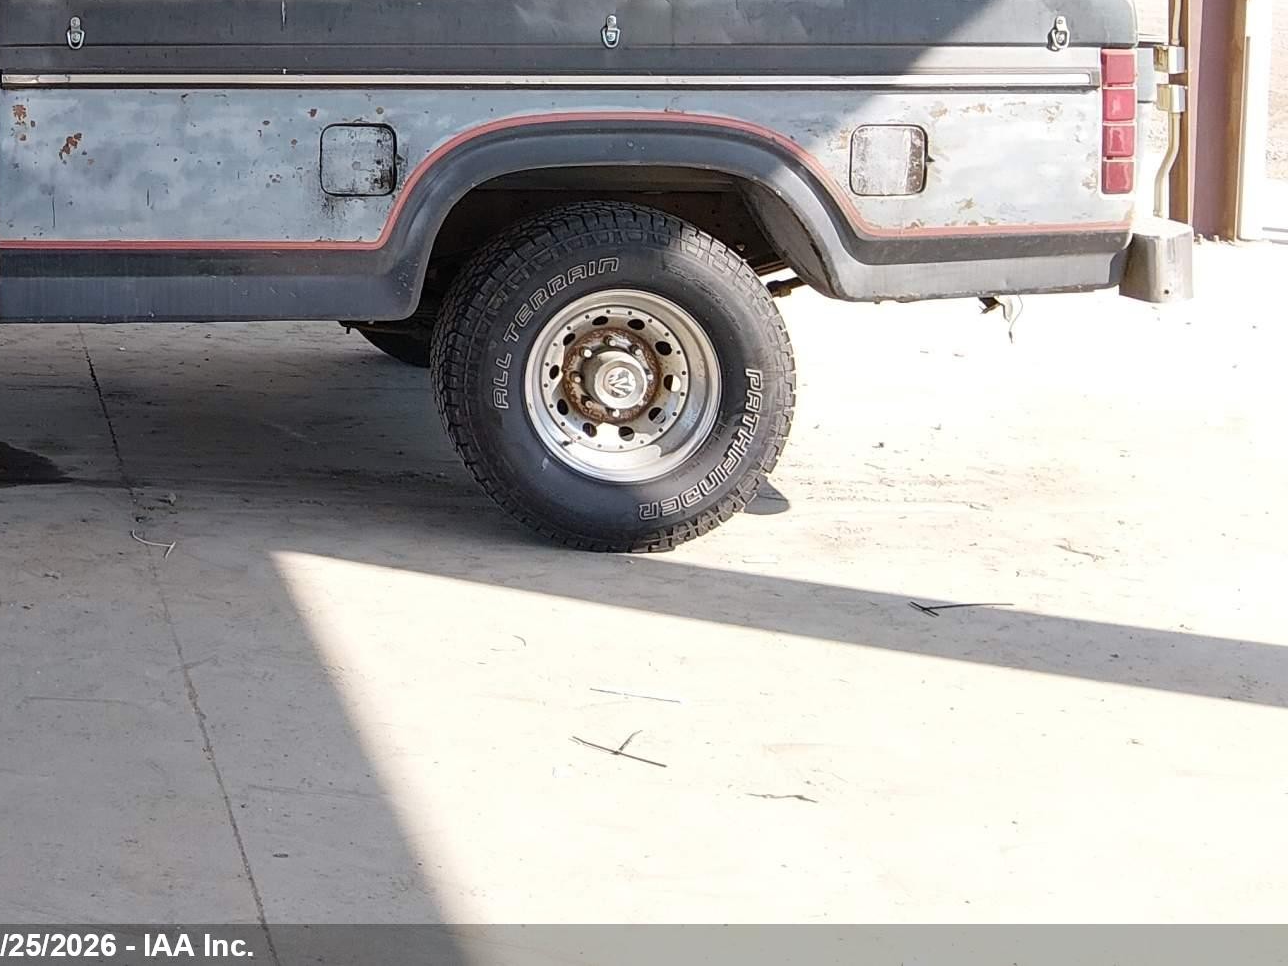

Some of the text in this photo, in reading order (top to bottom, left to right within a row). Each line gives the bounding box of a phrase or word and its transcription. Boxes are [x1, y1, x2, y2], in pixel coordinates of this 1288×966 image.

[492, 256, 620, 410] ALL TERRAIN
[639, 367, 763, 521] PATHFINDER
